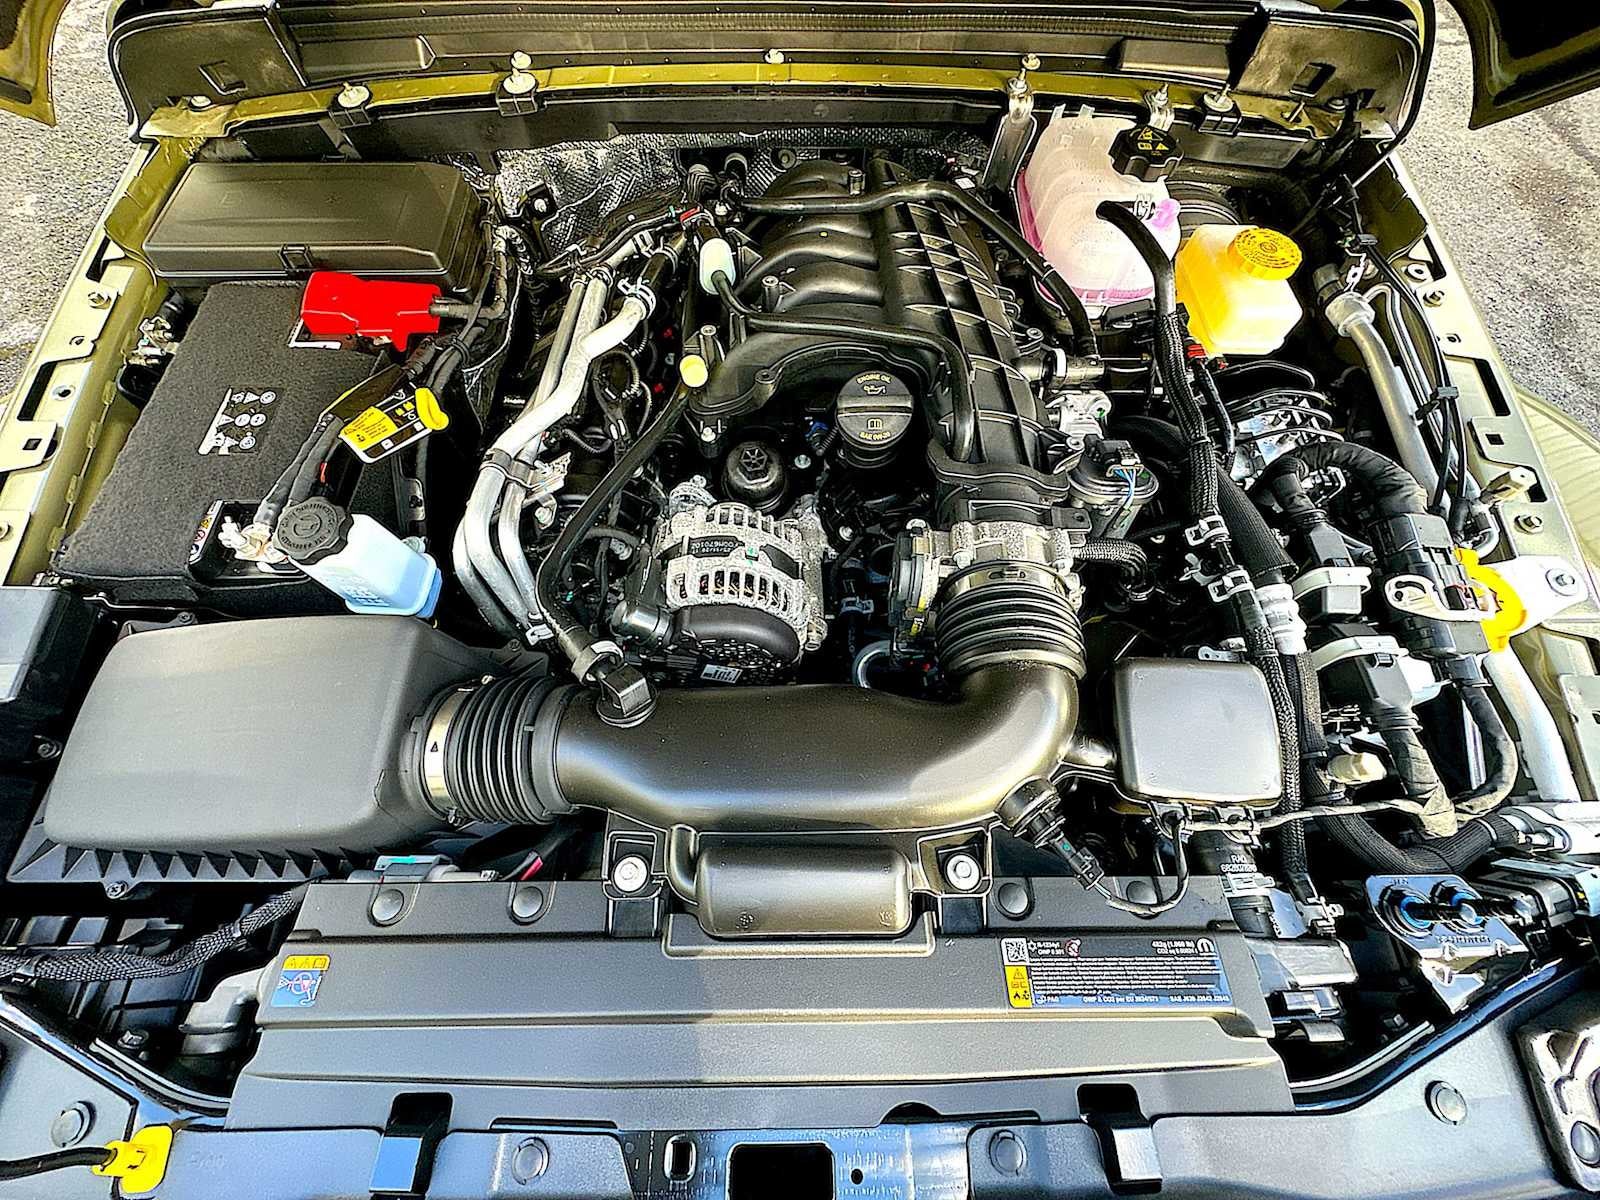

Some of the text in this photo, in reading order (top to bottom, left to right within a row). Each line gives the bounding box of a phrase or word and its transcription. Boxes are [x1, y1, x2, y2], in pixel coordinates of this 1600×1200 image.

[856, 373, 892, 384] ENGINE OIL
[860, 431, 873, 440] SAE
